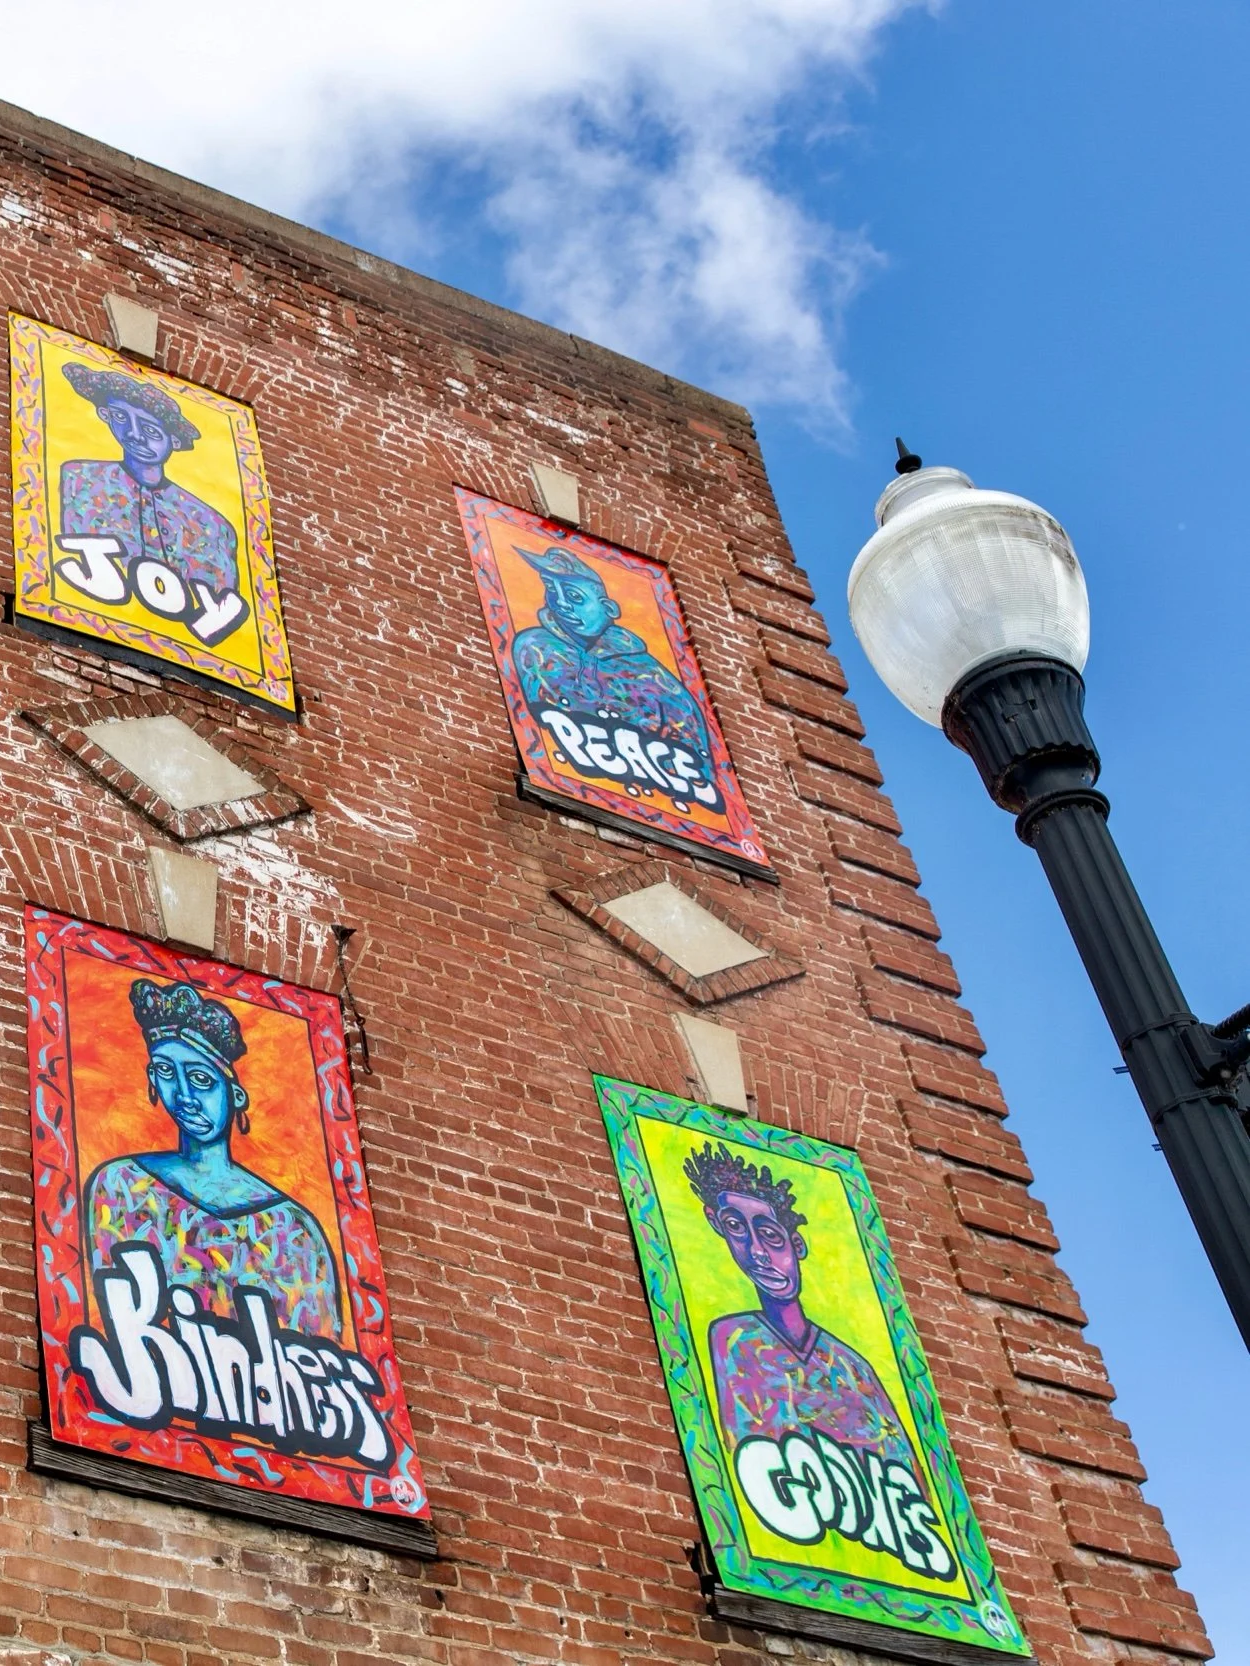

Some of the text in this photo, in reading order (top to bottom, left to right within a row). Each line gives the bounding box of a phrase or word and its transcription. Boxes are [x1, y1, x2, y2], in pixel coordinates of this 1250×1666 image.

[55, 535, 247, 645] JOY
[535, 706, 722, 810] PEACE
[75, 1245, 391, 1466] Kindness
